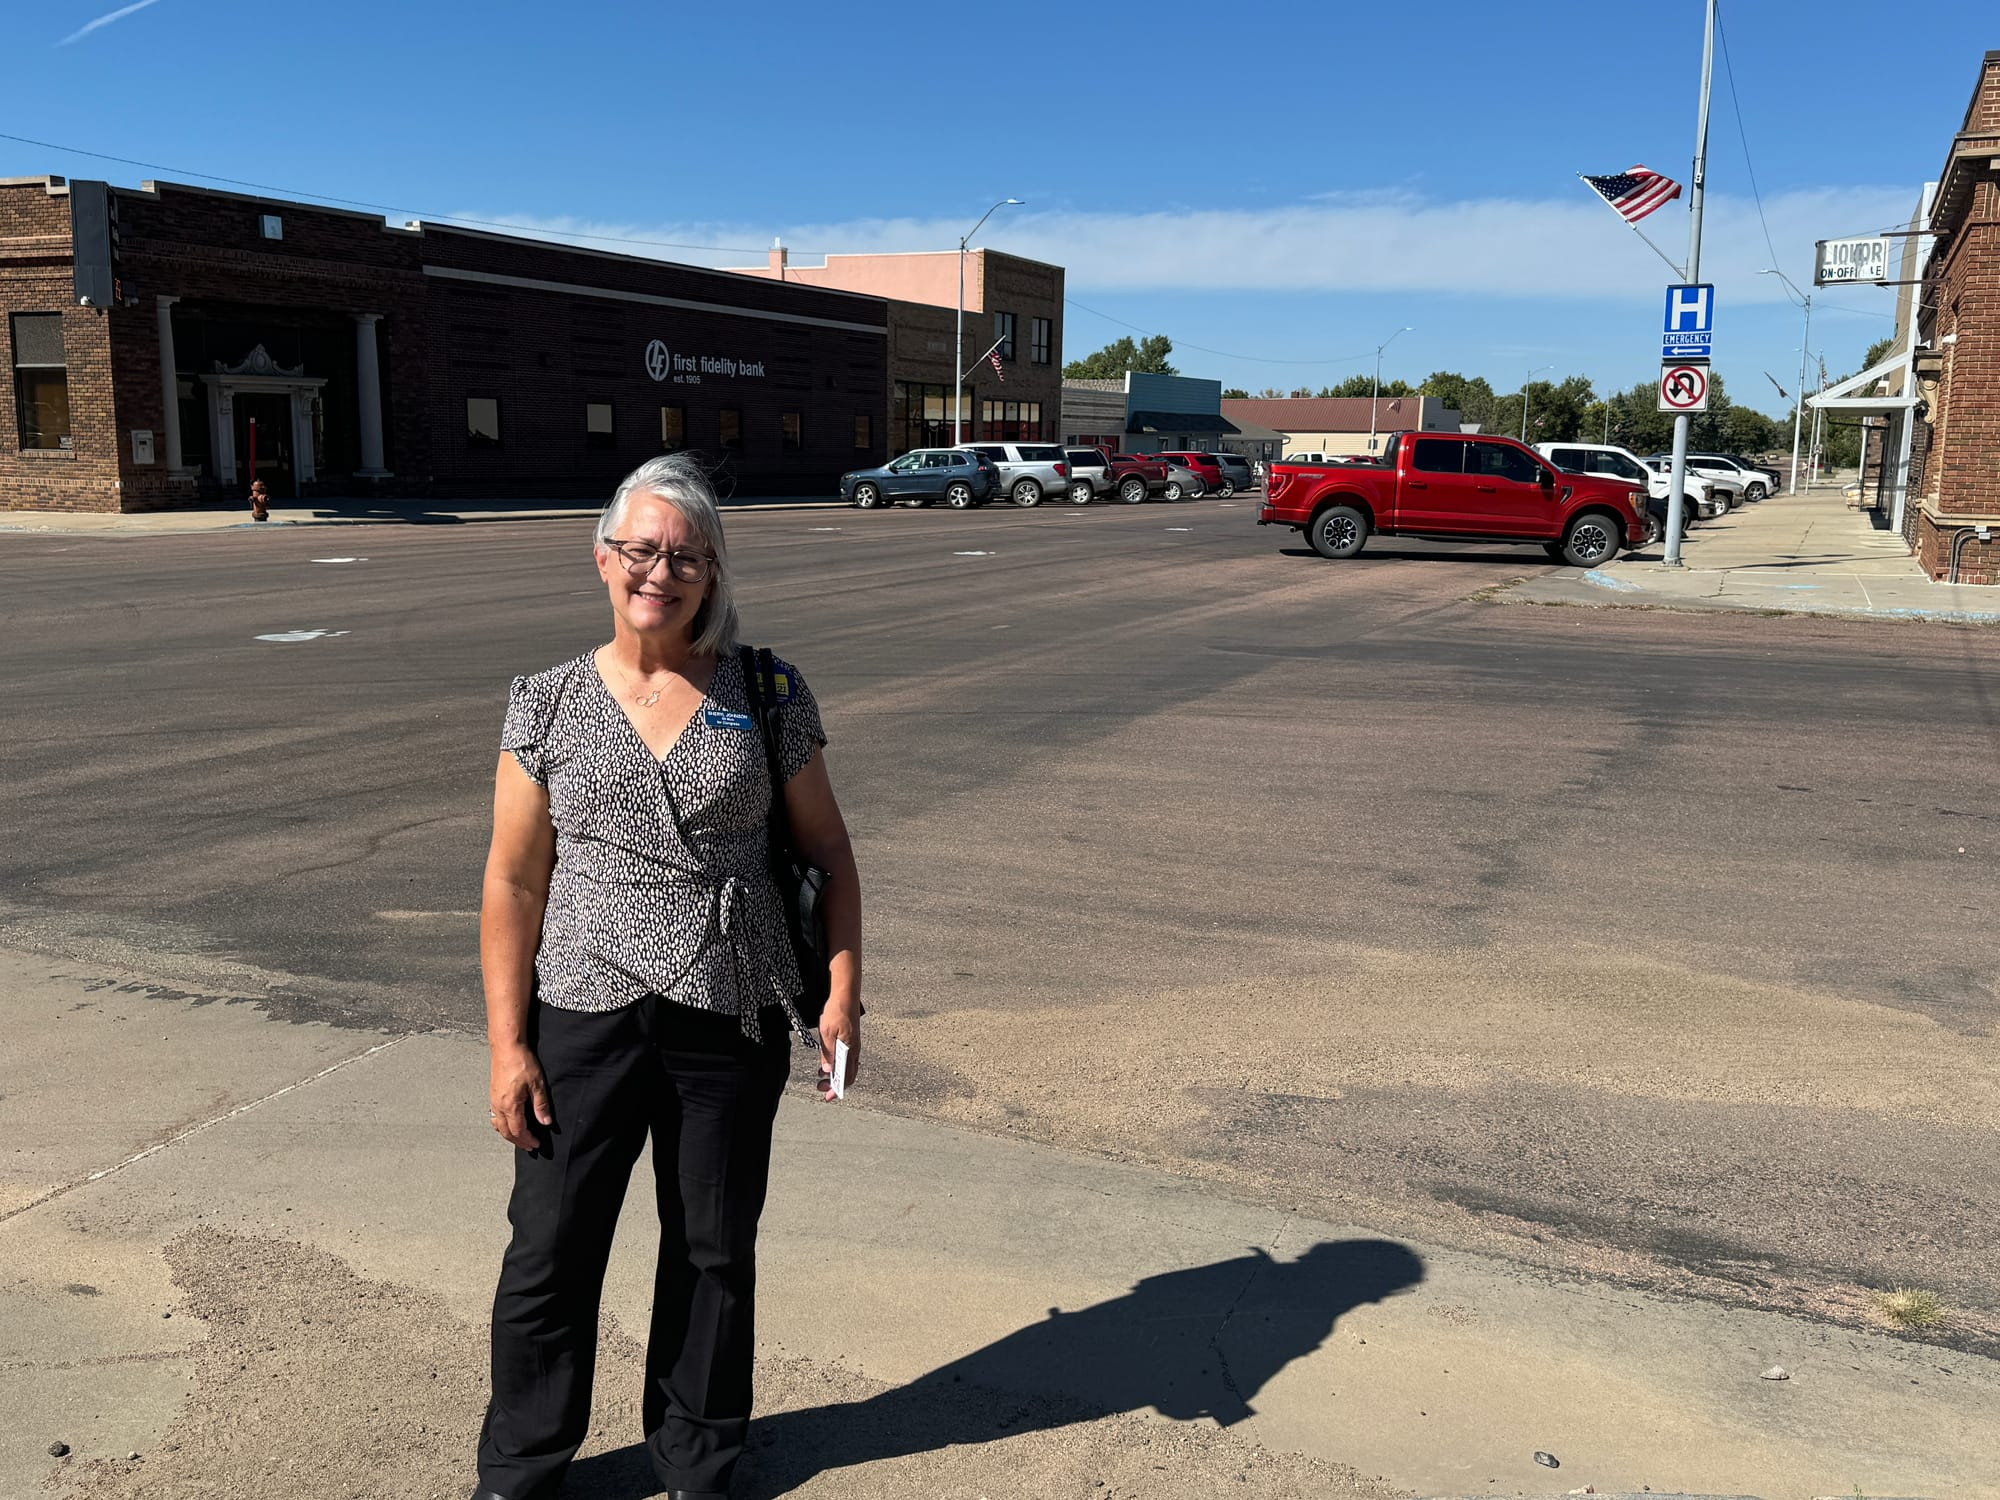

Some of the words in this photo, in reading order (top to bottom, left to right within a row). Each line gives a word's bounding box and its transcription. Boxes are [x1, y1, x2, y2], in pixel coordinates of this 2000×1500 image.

[1671, 288, 1708, 330] H
[1665, 334, 1710, 344] EMERGENCY
[673, 353, 697, 372] first
[700, 356, 736, 378] fidelity
[739, 359, 765, 377] bank
